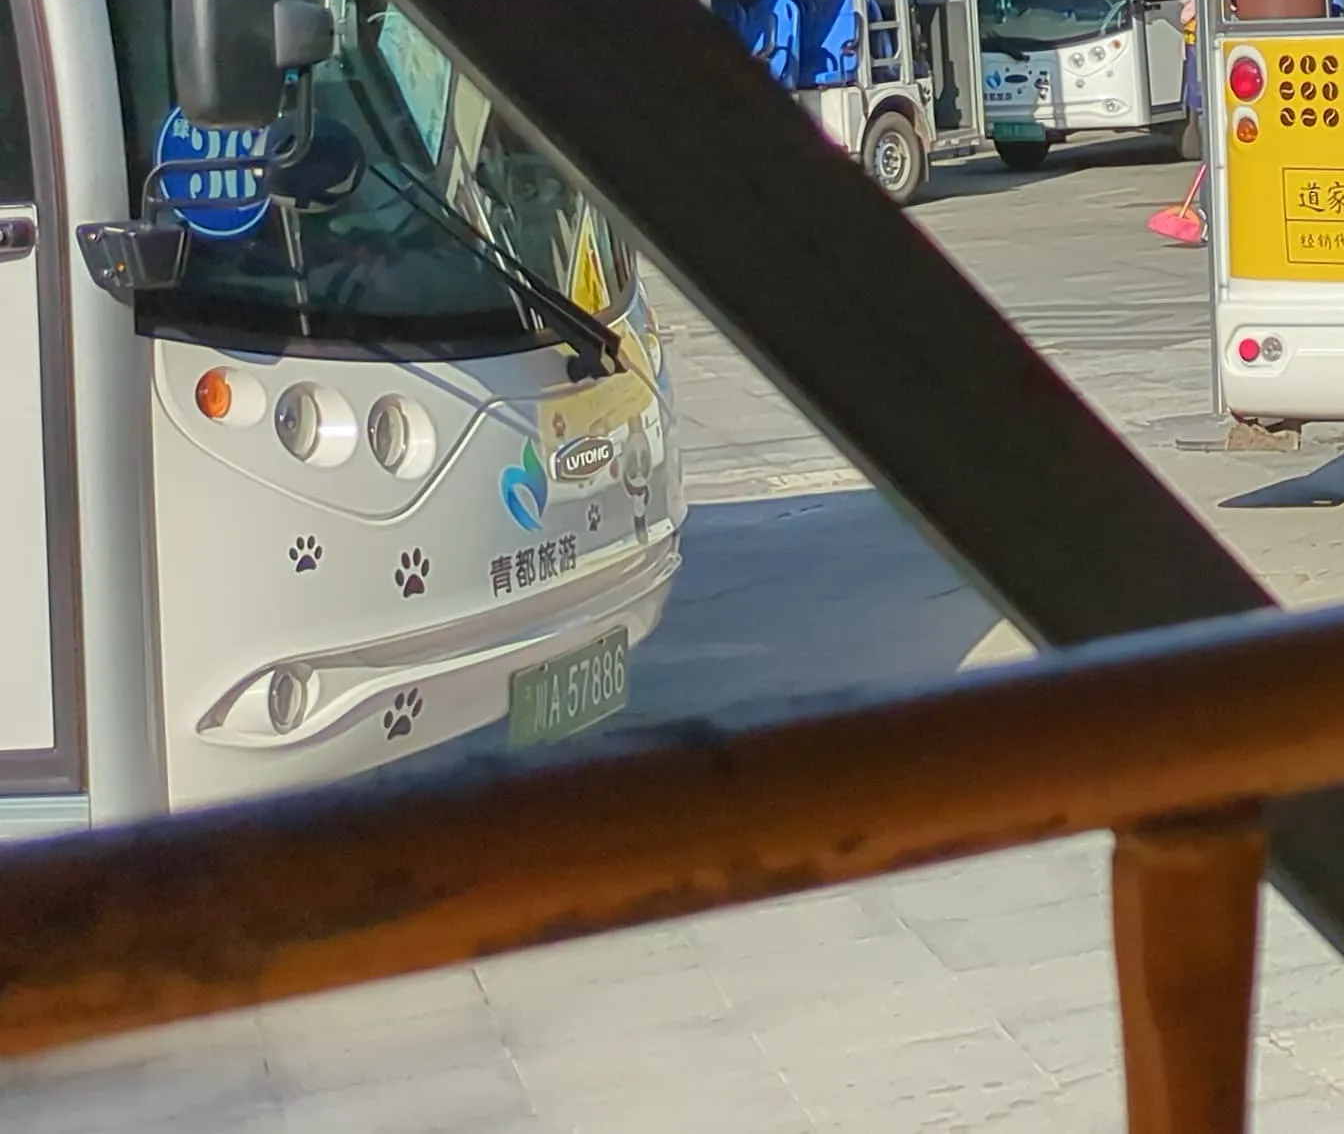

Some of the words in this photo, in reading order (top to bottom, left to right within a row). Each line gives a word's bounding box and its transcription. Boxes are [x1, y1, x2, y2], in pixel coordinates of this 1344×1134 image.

[566, 444, 609, 471] LVTONG
[490, 533, 576, 598] 青都旅游
